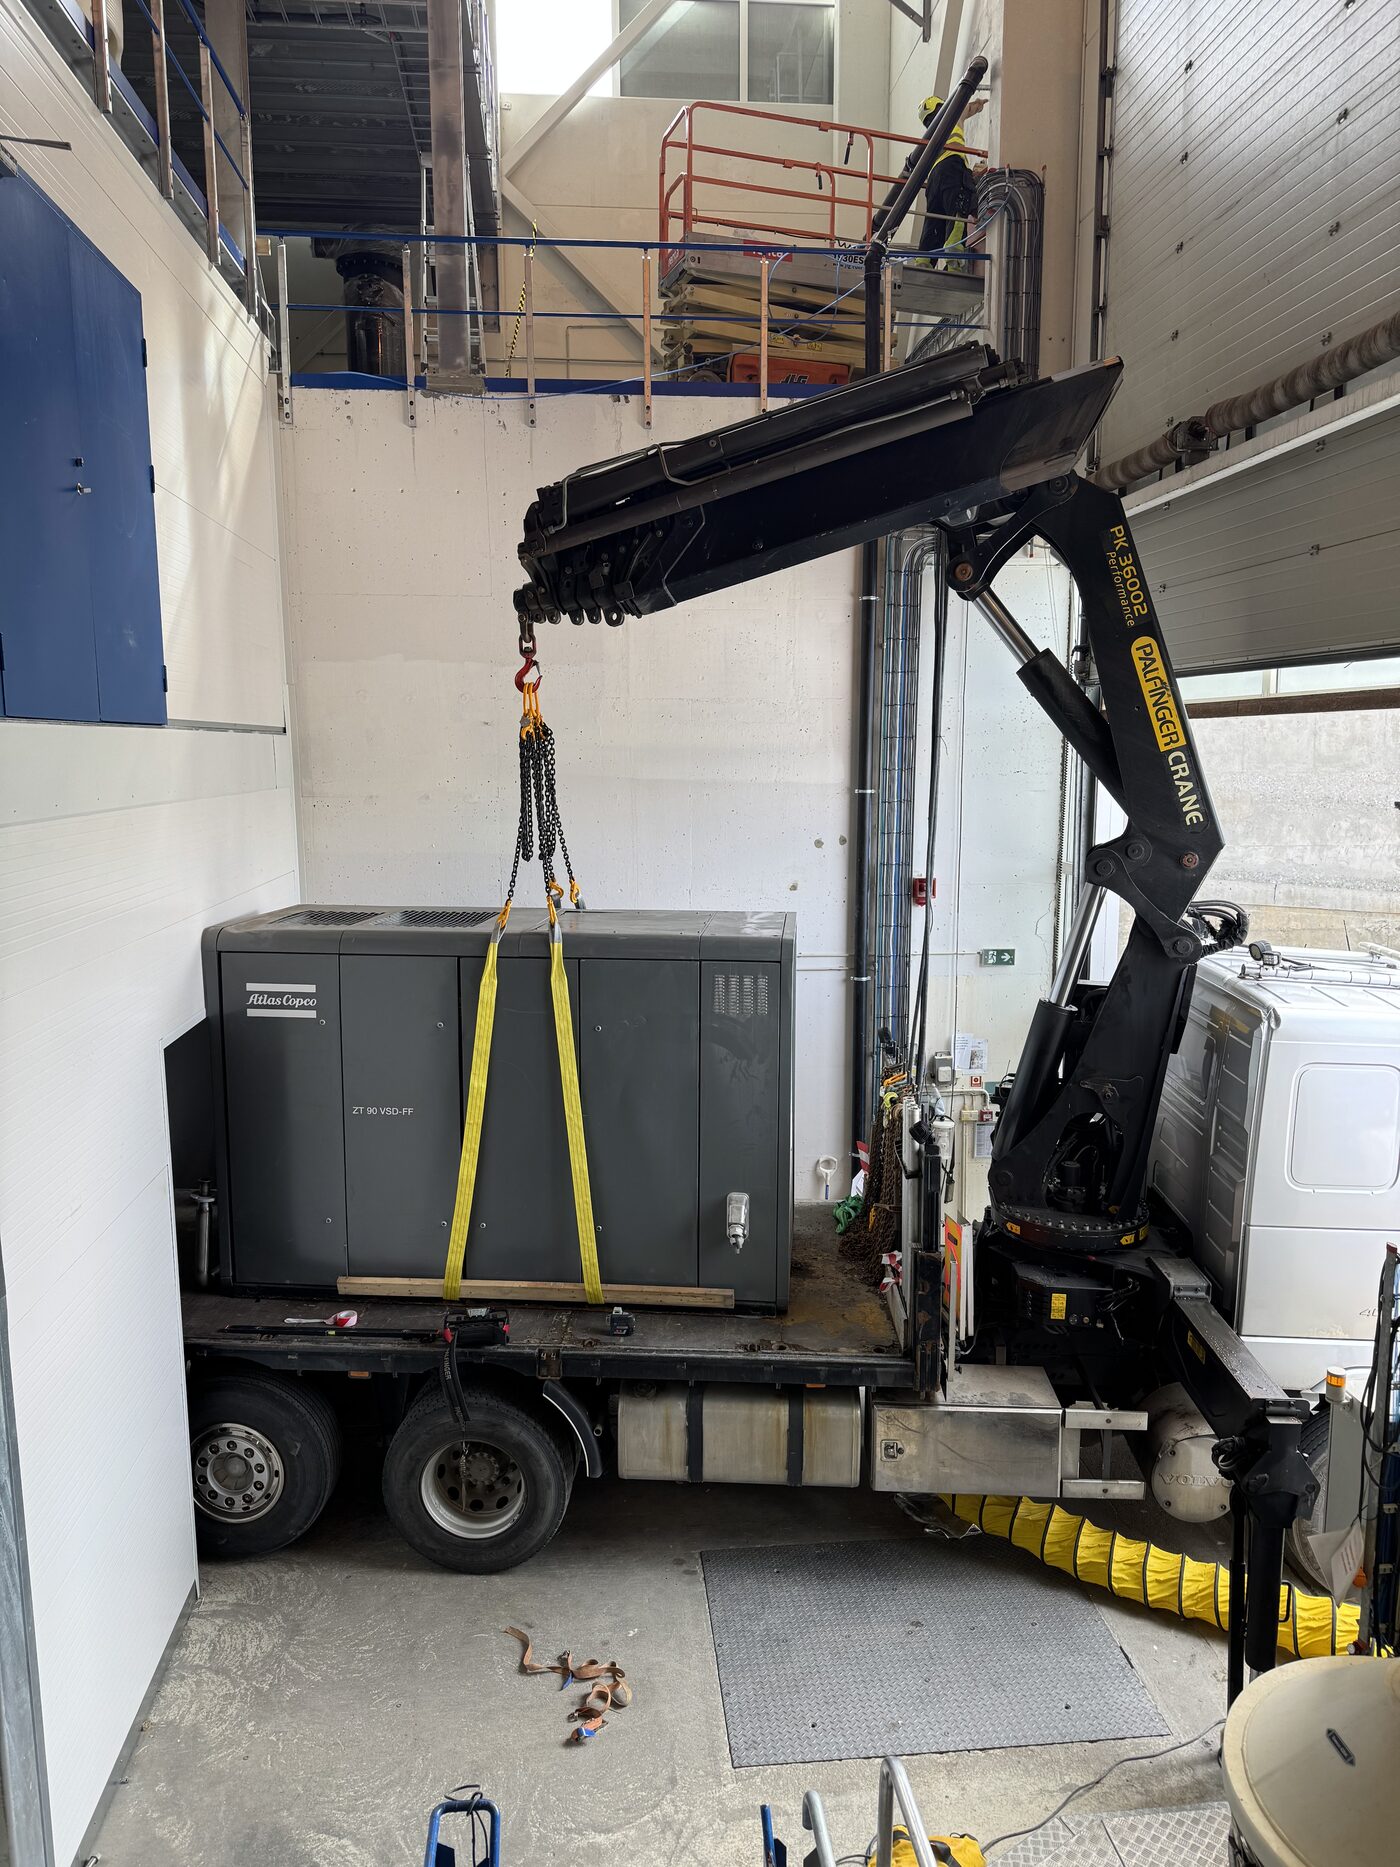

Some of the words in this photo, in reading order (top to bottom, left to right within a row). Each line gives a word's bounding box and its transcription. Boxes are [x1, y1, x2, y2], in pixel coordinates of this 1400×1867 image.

[1110, 525, 1129, 551] PK
[1106, 551, 1135, 627] Performance
[1118, 553, 1148, 617] 36002
[1136, 642, 1180, 747] PALFINGER
[1167, 750, 1205, 826] CRANE
[246, 993, 282, 1006] Atlas
[282, 994, 317, 1008] Copco
[352, 1106, 365, 1115] ZT
[366, 1106, 378, 1115] 90
[379, 1107, 414, 1116] VSD-FF
[1159, 1472, 1234, 1489] VOLVO
